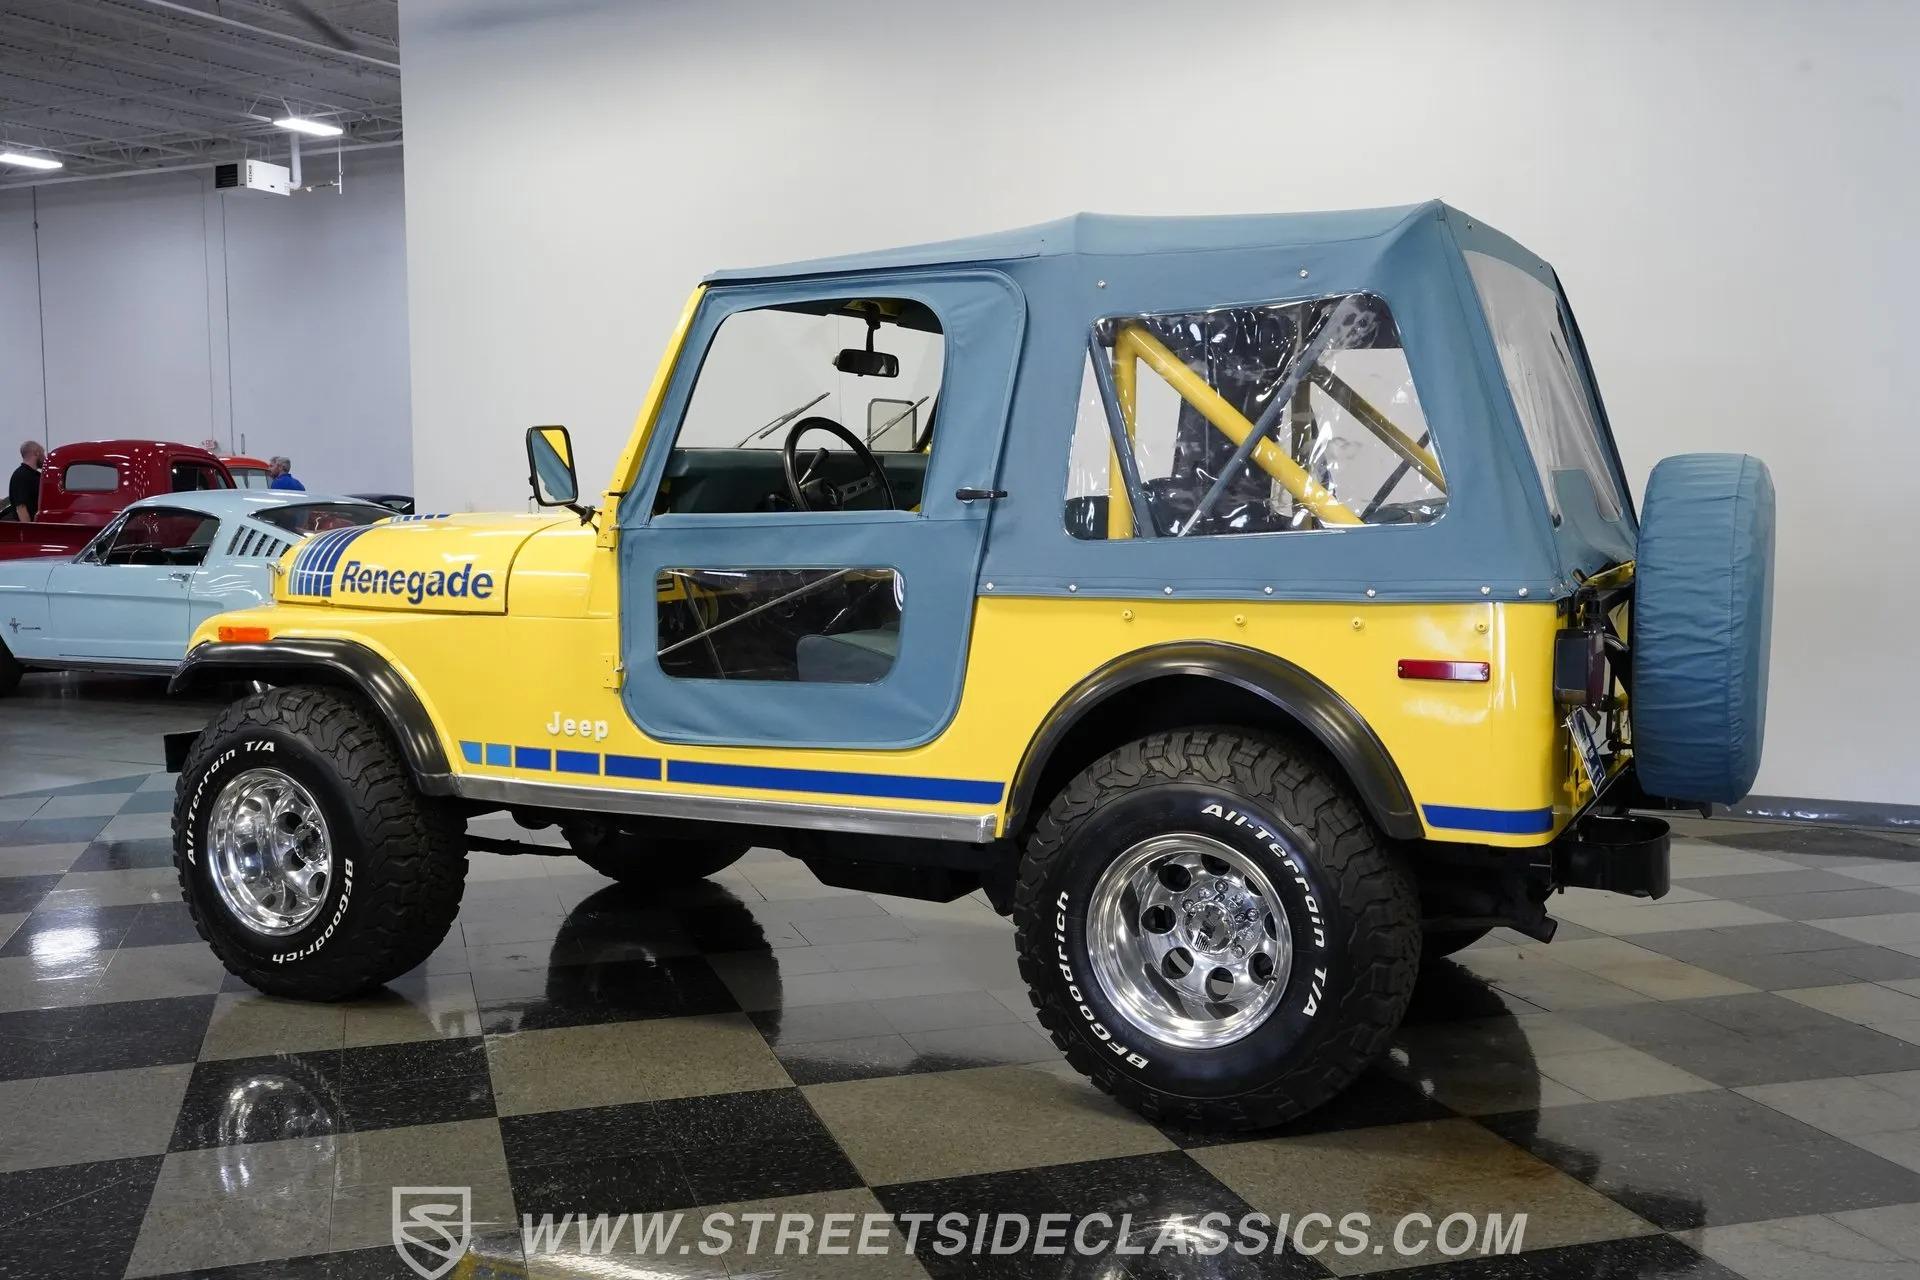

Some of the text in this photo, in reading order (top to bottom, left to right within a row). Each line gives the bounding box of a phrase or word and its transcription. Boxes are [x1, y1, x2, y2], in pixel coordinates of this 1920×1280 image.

[340, 560, 493, 605] Renegade
[545, 711, 609, 743] Jeep
[186, 740, 275, 866] All-Terrain T/A
[272, 858, 354, 965] BFGoodrich
[1201, 804, 1328, 1018] All-Terrain T/A
[1054, 890, 1151, 1070] BFGoodrich
